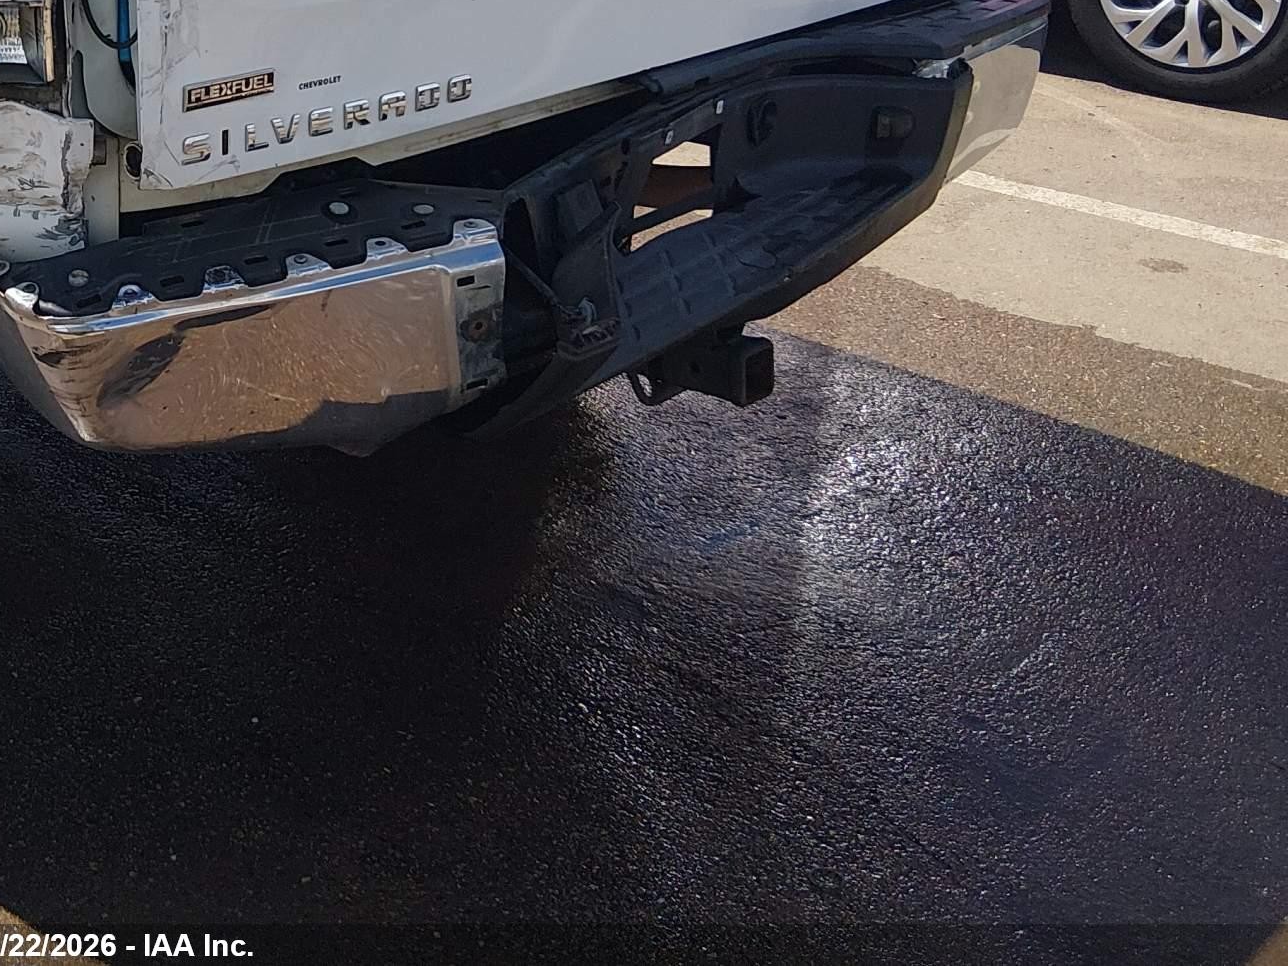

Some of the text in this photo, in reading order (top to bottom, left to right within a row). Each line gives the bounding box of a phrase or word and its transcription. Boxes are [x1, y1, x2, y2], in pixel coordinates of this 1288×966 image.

[190, 74, 273, 103] FLEXFUEL
[298, 75, 342, 91] CHEVROLET
[181, 73, 473, 166] SILVERADO
